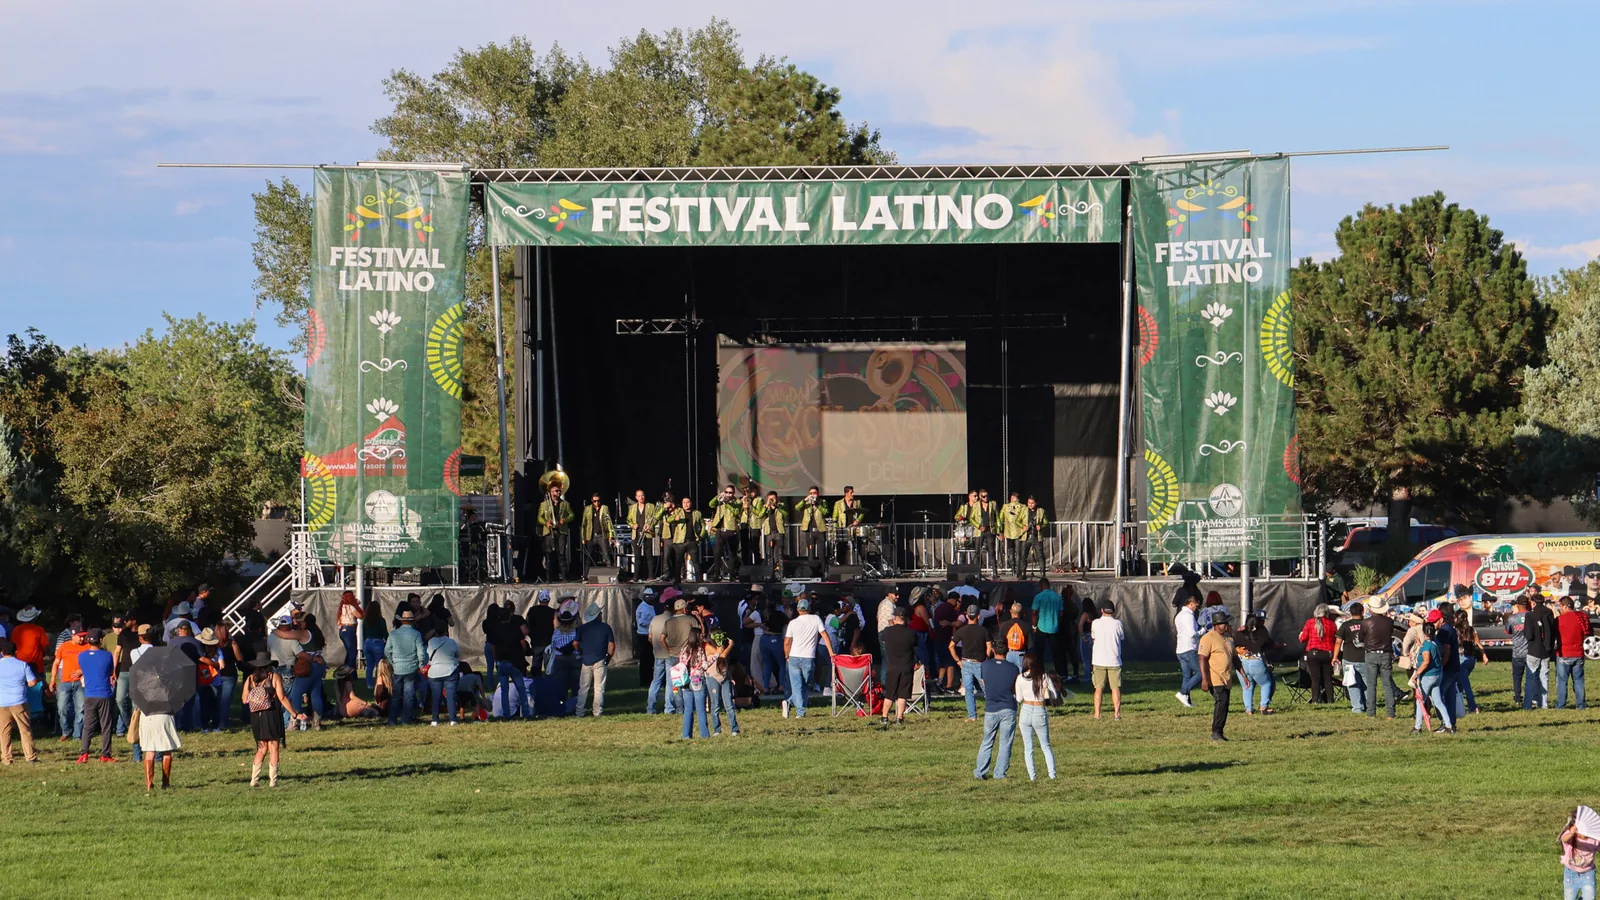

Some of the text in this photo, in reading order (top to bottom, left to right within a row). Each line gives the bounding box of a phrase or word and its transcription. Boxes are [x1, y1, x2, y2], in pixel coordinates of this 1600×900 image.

[591, 193, 1014, 233] FESTIVAL LATINO
[329, 246, 446, 269] FESTIVAL
[1154, 237, 1272, 263] FESTIVAL
[338, 270, 435, 292] LATINO
[1166, 261, 1263, 287] LATINO
[347, 522, 418, 534] ADAMS COUNTY
[1192, 518, 1260, 528] ADAMS COUNTY
[1545, 540, 1592, 548] INVADIENDO
[1481, 572, 1521, 587] 87.7
